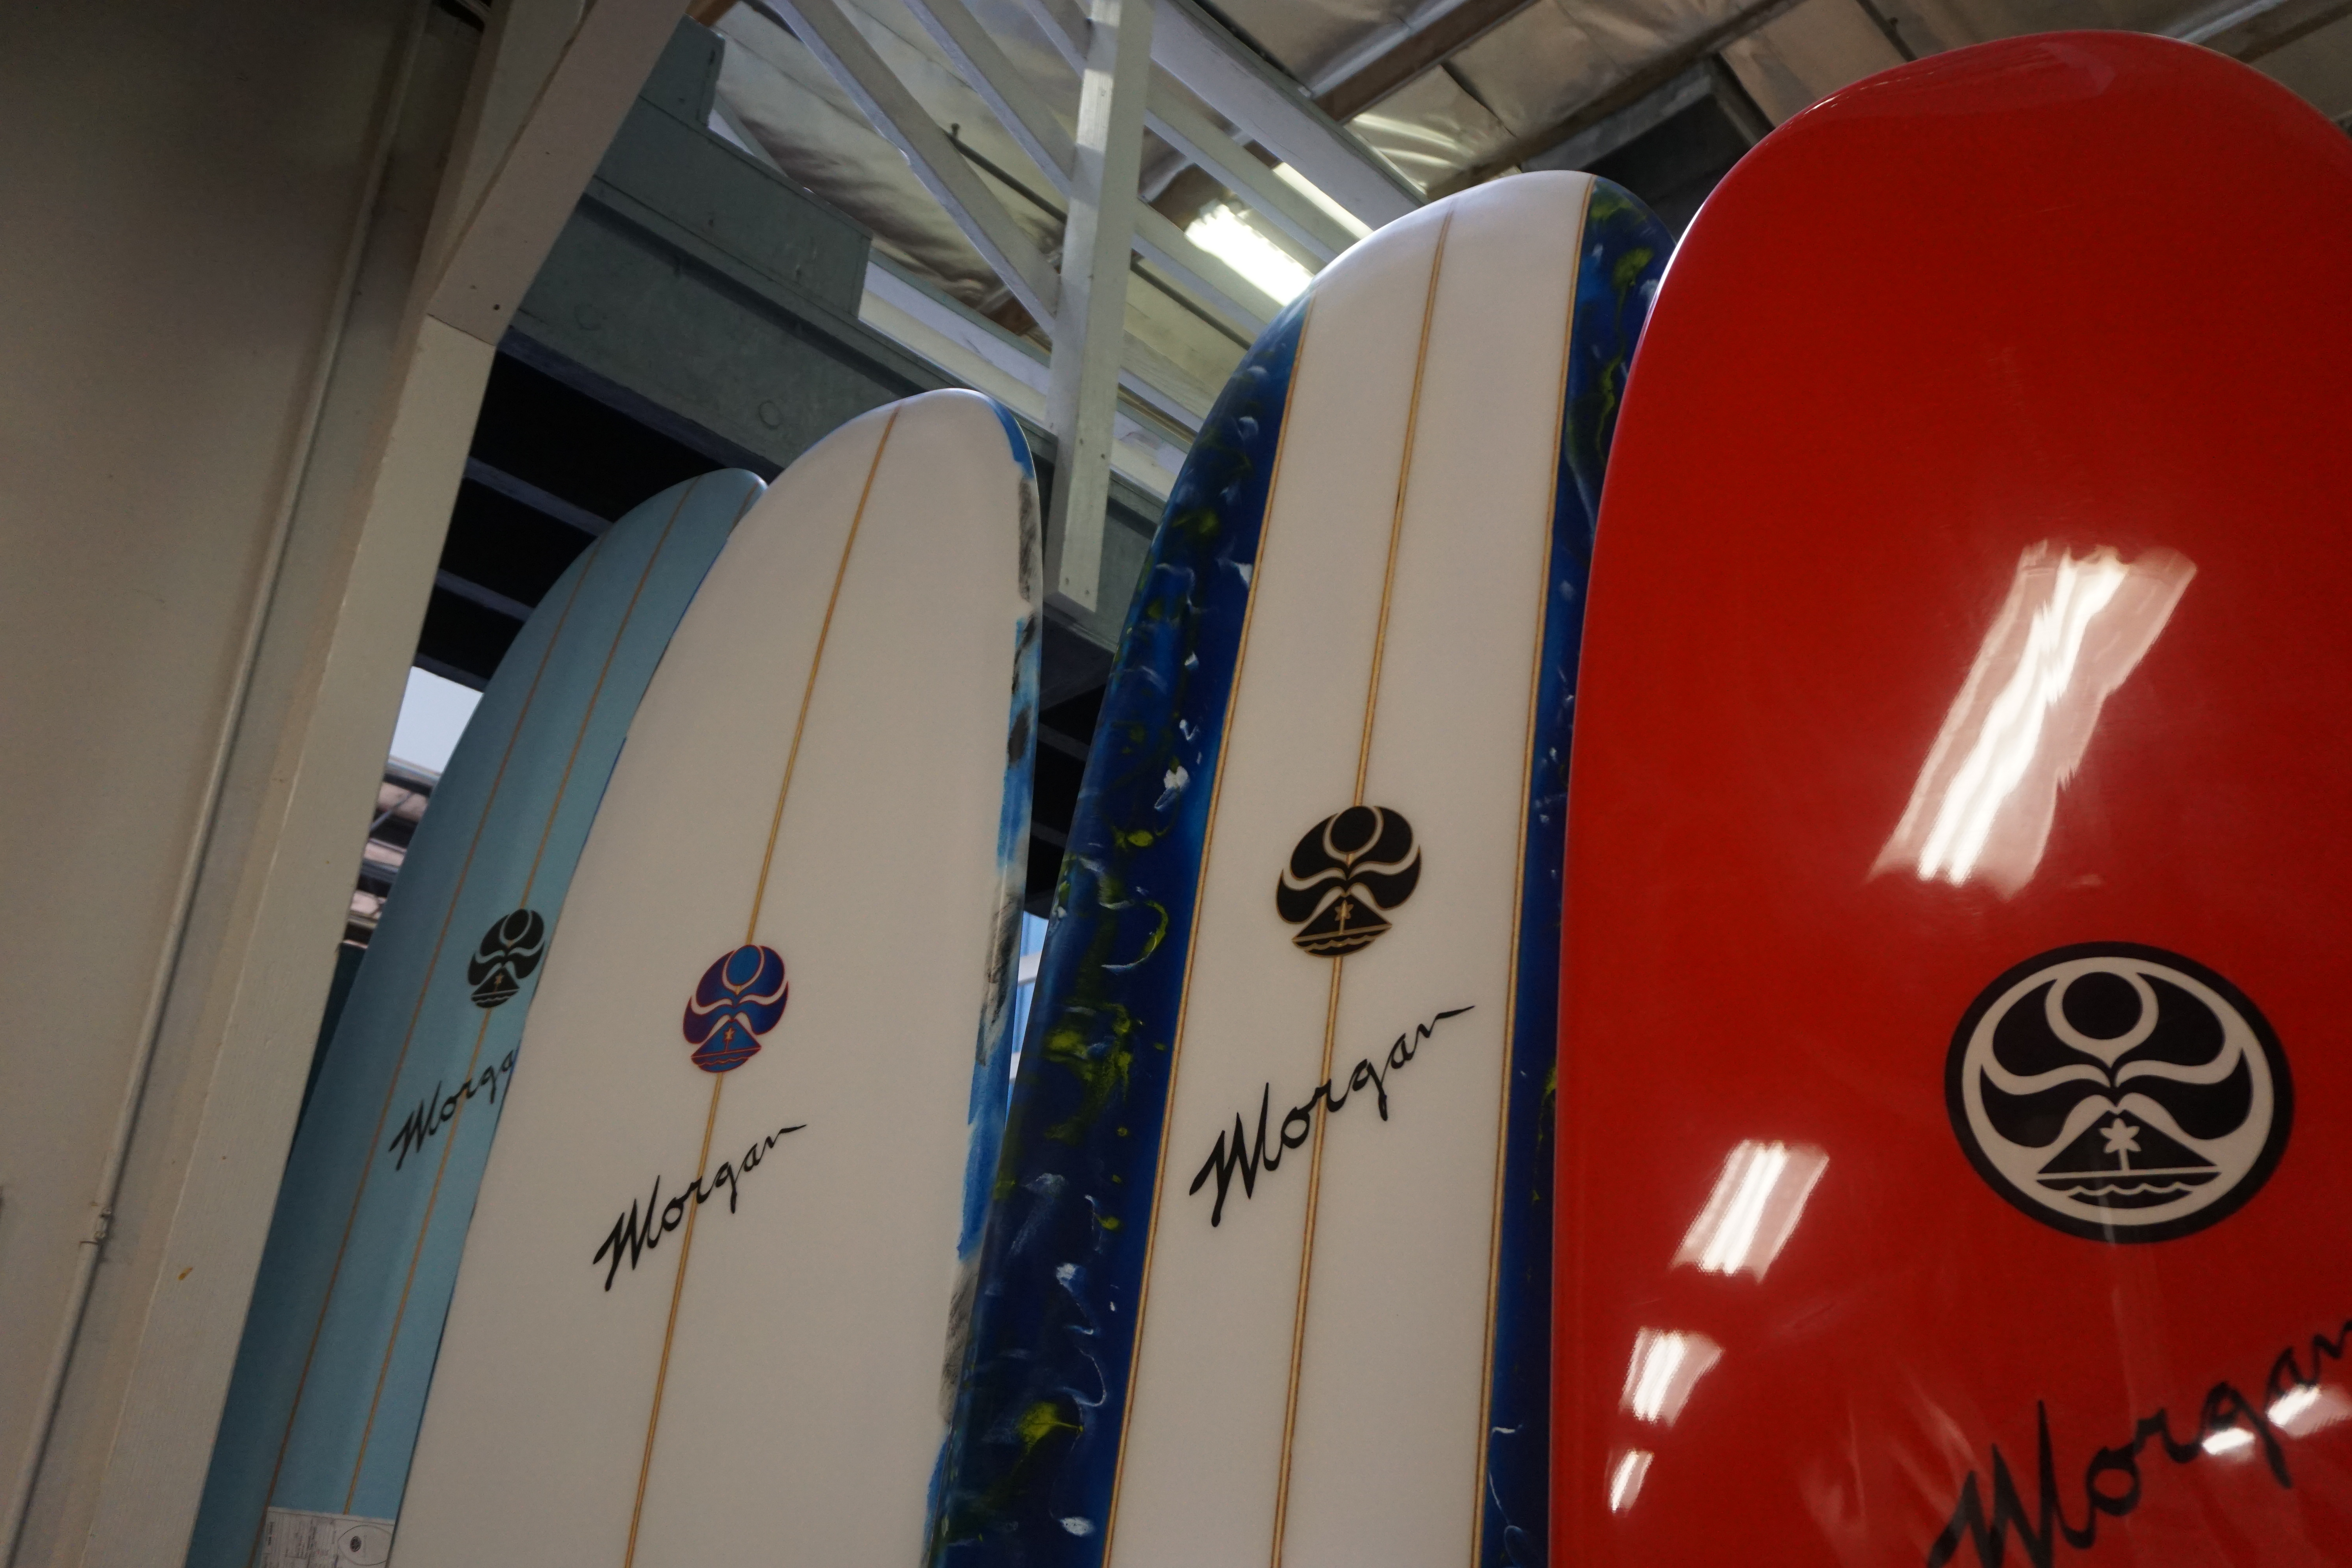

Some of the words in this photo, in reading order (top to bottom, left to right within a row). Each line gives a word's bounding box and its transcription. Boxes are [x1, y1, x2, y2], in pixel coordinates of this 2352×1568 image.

[388, 1049, 515, 1171] Morga
[1189, 1005, 1475, 1228] Morgan
[592, 1124, 807, 1292] Morgan
